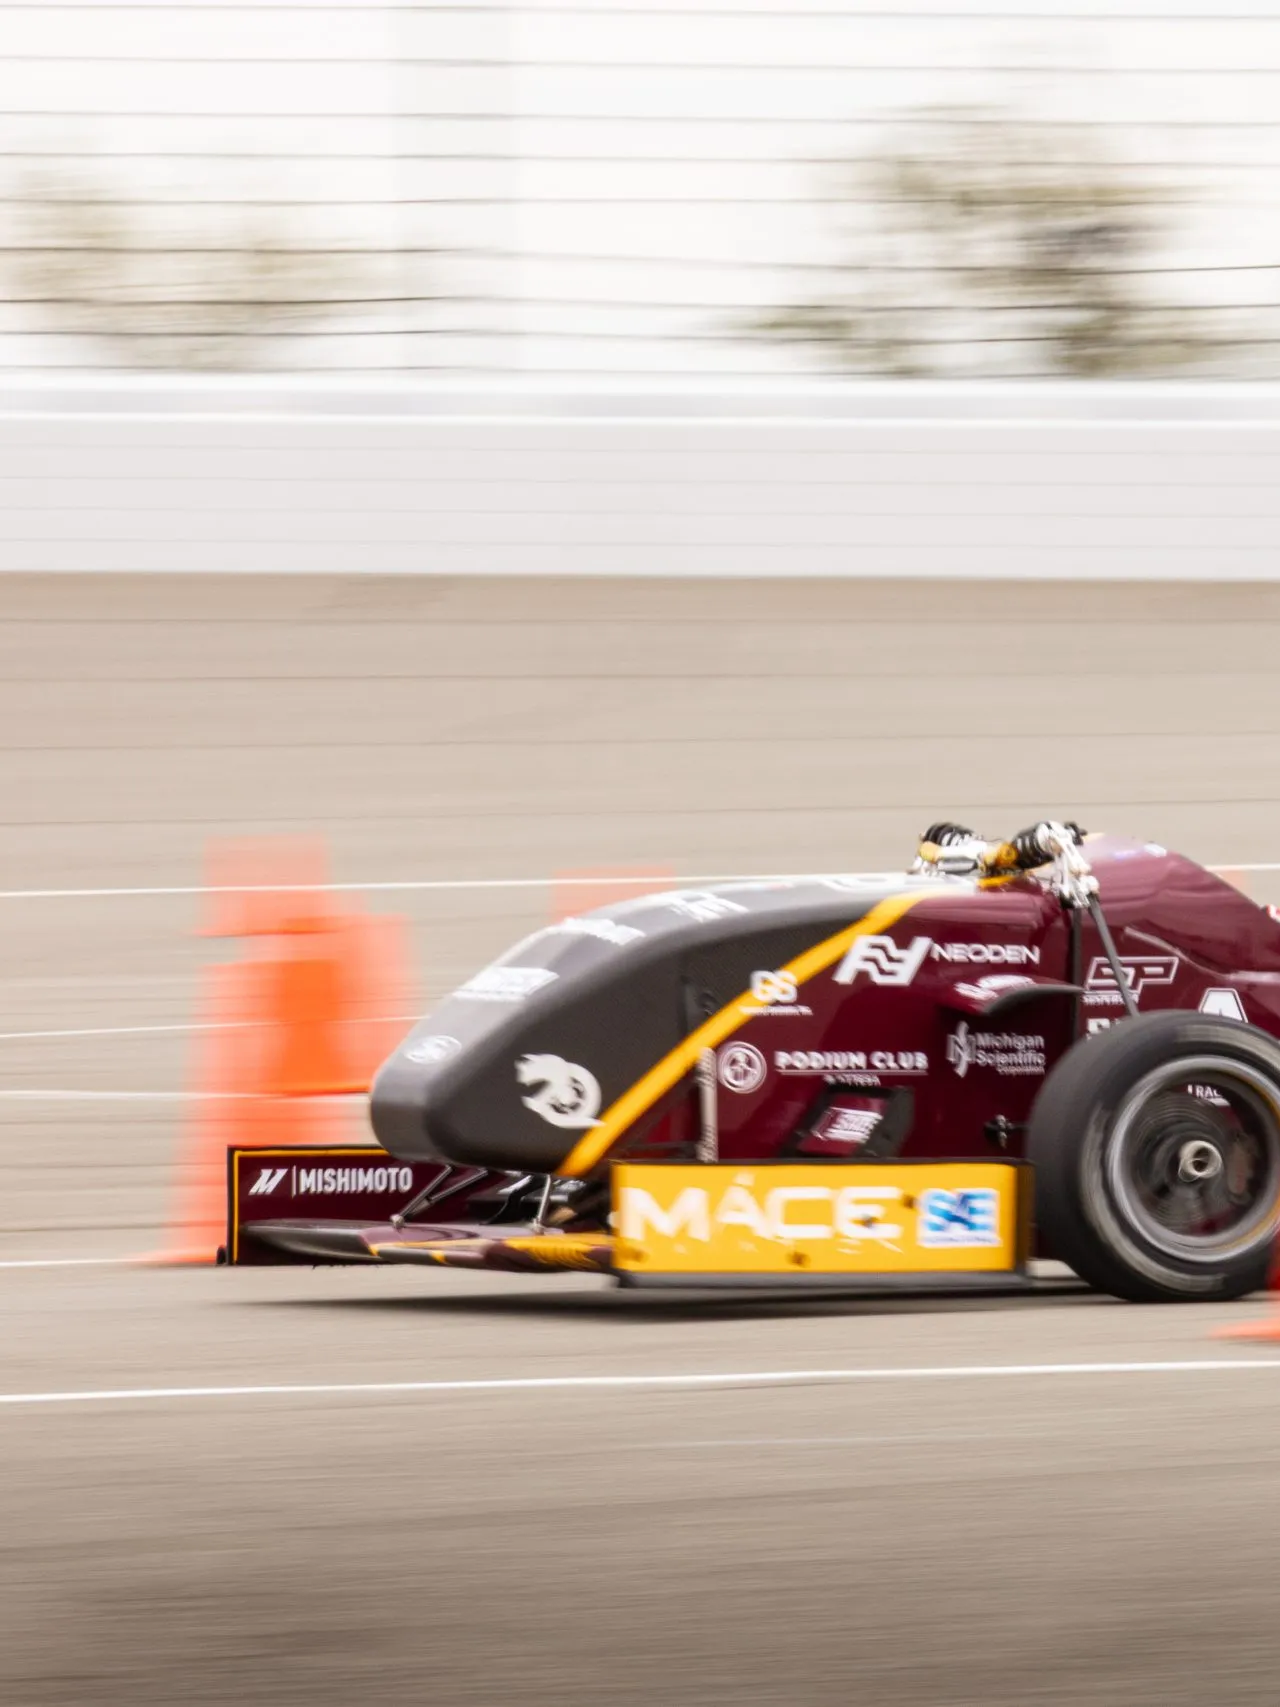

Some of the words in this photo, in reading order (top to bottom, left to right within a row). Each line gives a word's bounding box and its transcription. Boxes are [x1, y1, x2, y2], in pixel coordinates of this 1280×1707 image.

[931, 943, 1040, 964] NEODEN
[974, 1033, 1045, 1051] Michigan
[773, 1051, 867, 1070] PODIUM
[869, 1051, 929, 1070] CLUB
[299, 1167, 413, 1194] MISHIMOTO
